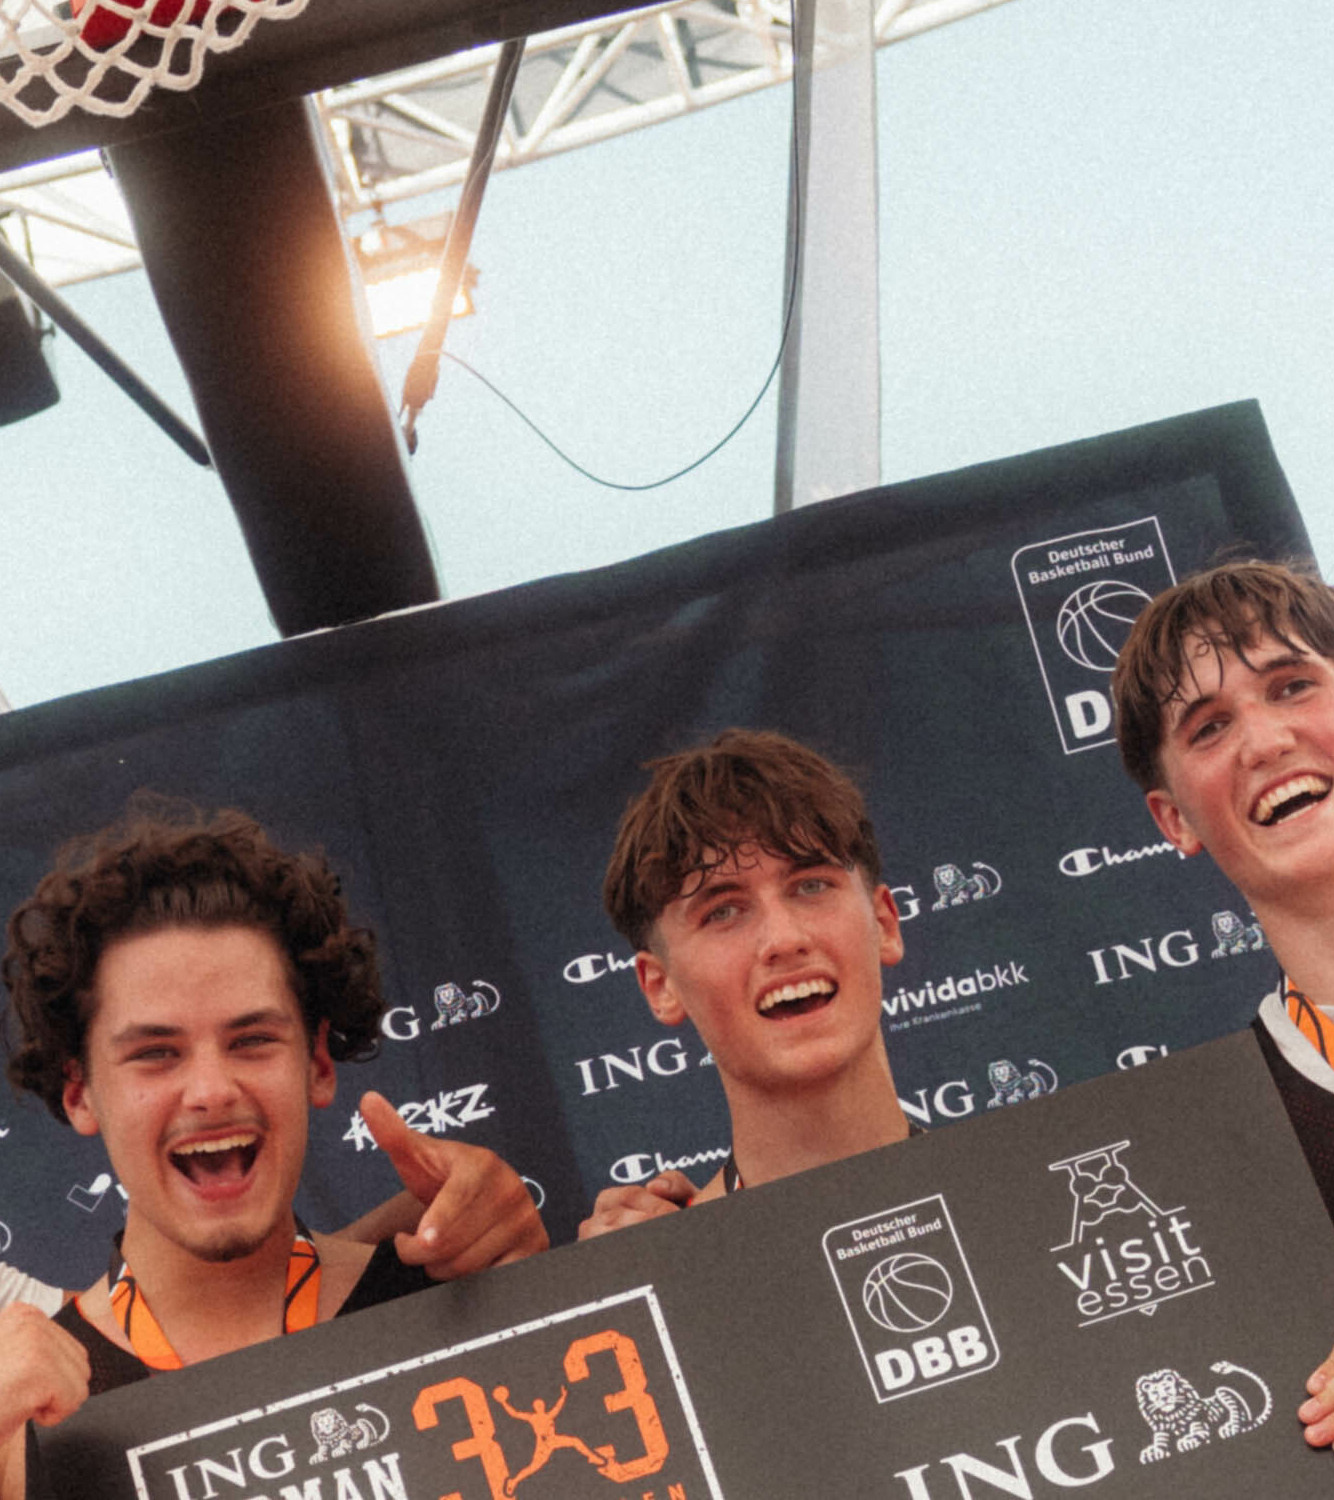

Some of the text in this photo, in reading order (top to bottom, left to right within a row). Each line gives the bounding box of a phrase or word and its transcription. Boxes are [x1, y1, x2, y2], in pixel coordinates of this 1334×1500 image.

[1028, 545, 1155, 585] Basketball Bund
[1048, 538, 1126, 564] Deutscher
[1089, 930, 1199, 986] ING
[576, 1037, 688, 1096] ING
[896, 1081, 976, 1123] NG
[610, 1146, 731, 1183] Cham
[836, 1217, 943, 1261] Basketball Bund
[851, 1211, 917, 1243] Deutscher
[1058, 1215, 1201, 1291] visit
[1077, 1254, 1212, 1316] essen
[874, 1324, 990, 1391] DBB
